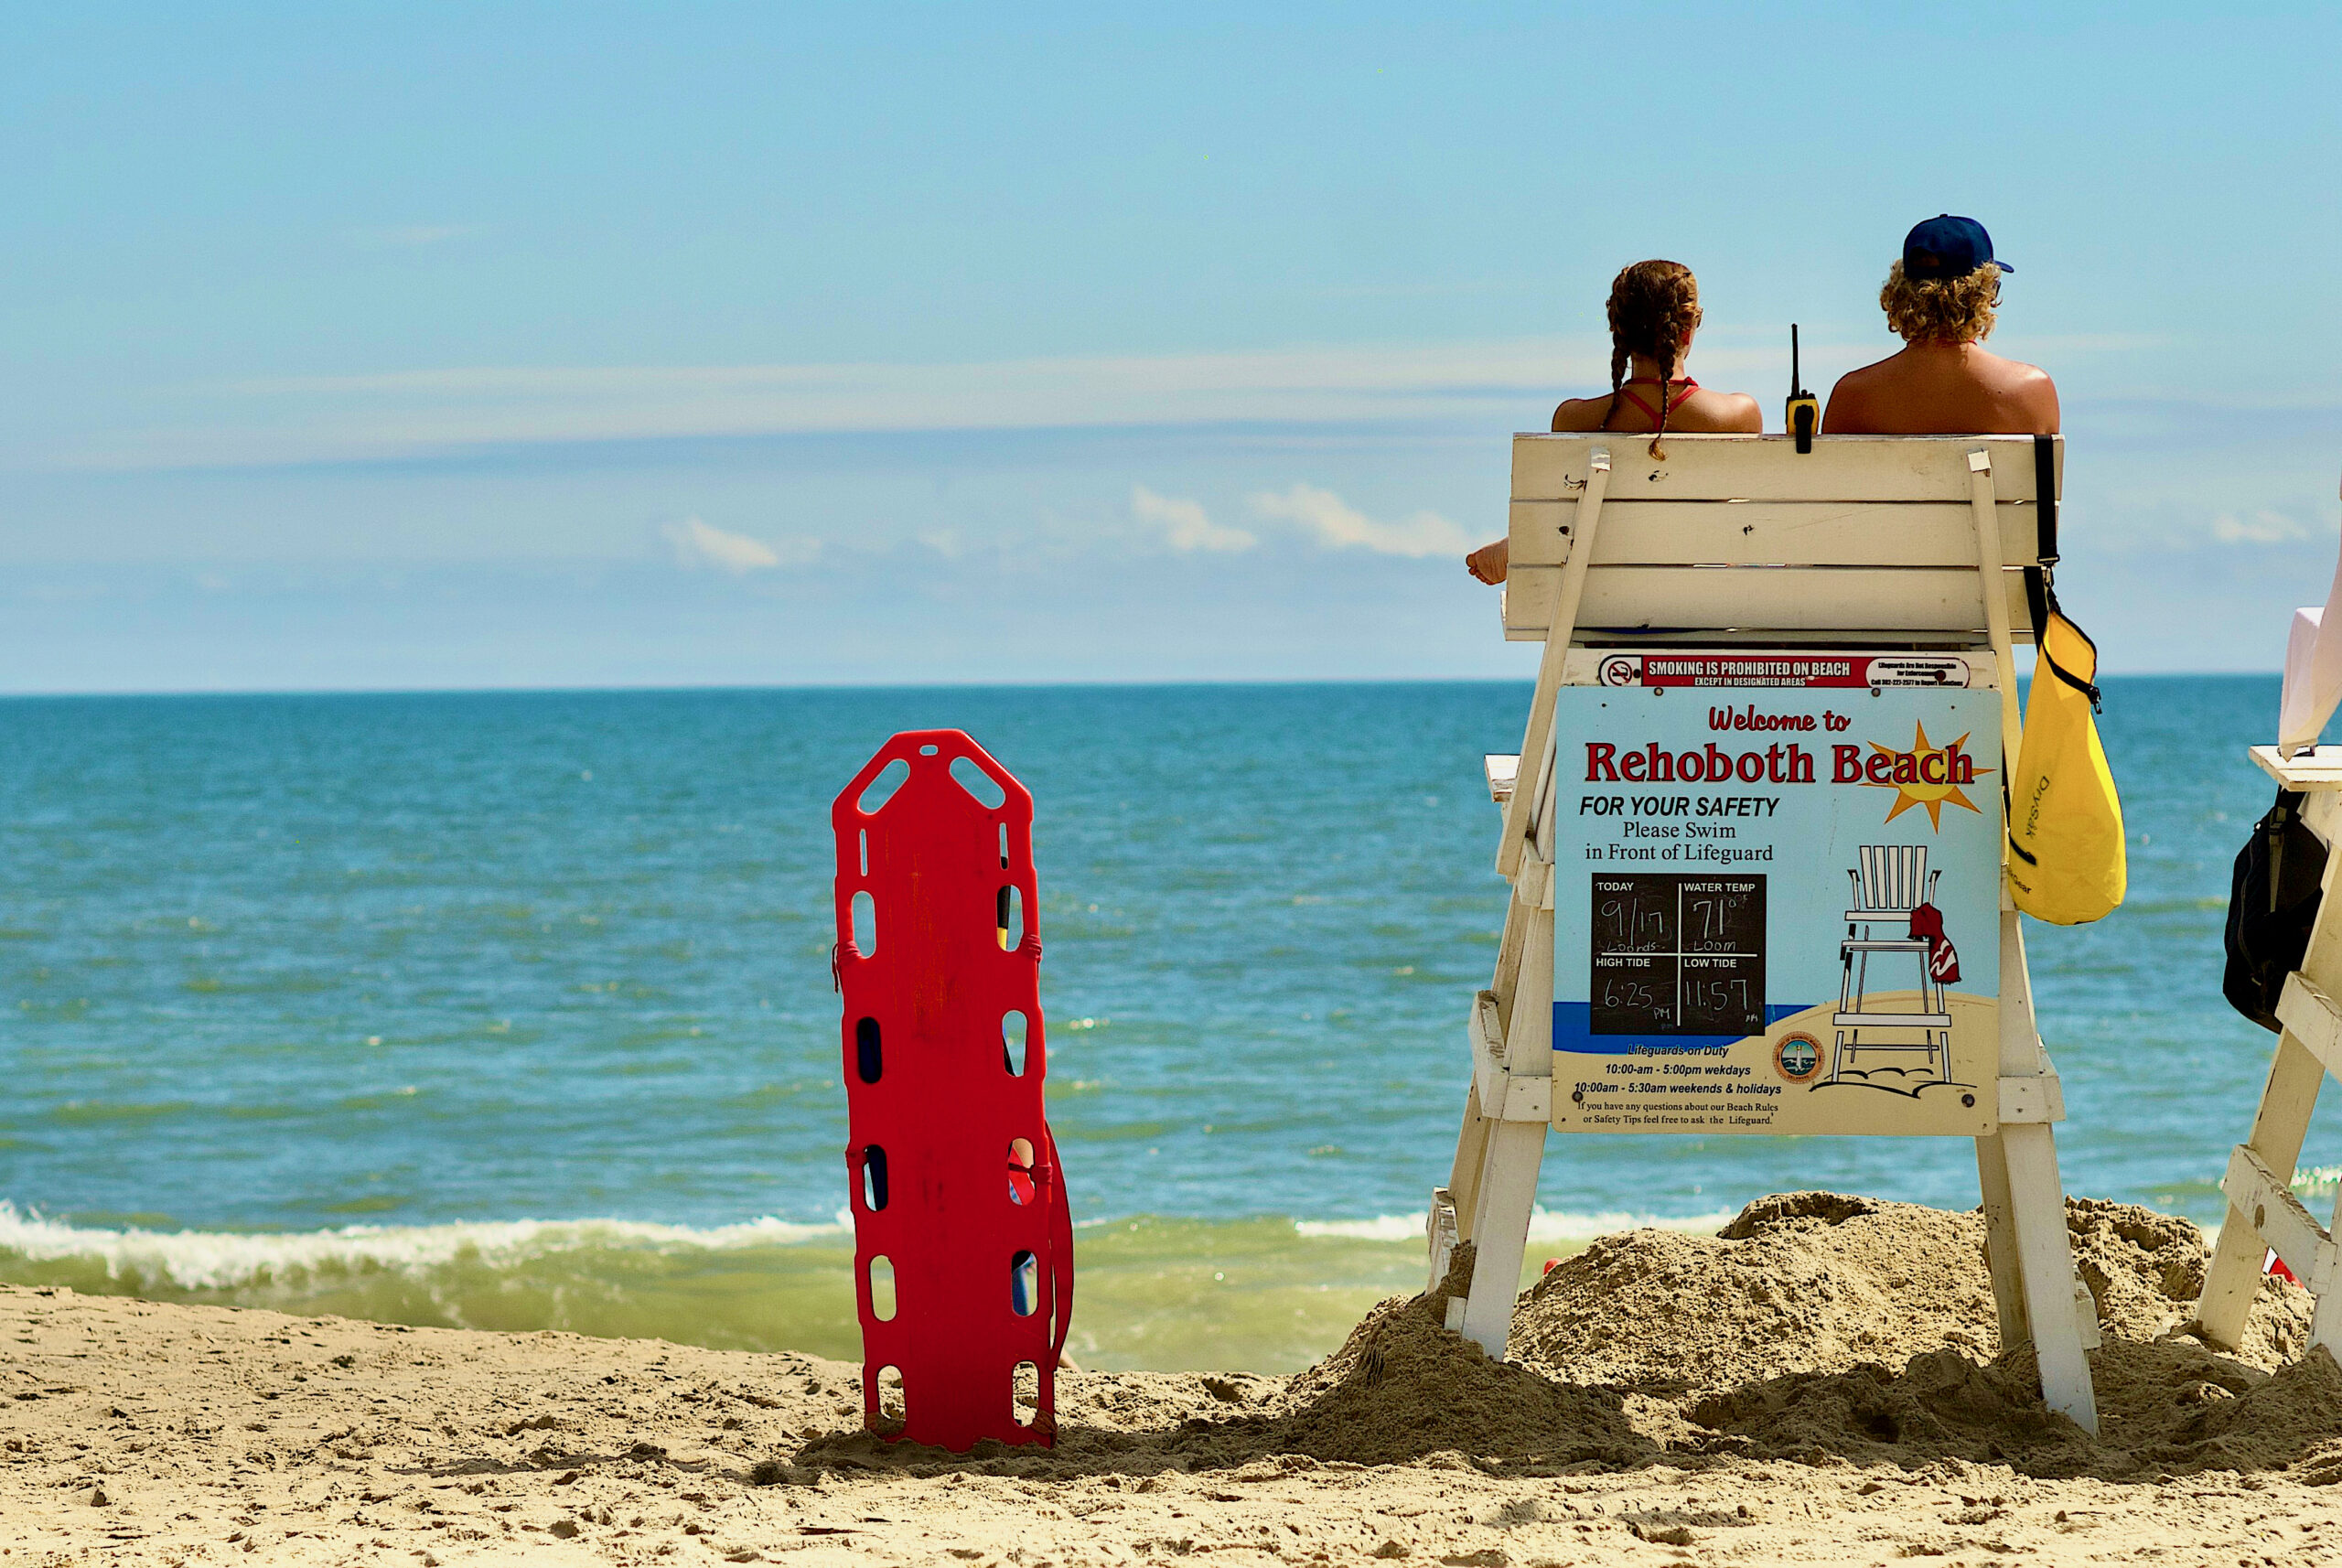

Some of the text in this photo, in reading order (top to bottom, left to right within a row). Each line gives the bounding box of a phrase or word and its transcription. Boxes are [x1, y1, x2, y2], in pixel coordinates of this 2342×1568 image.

[1649, 661, 1850, 676] SMOKING IS PROHIBITED ON BEACH
[1694, 677, 1806, 686] EXCEPT IN DESIGNATED AREAS
[1709, 704, 1851, 732] Welcome to
[1585, 742, 1974, 784] Rehoboth Beach
[1580, 797, 1779, 817] FOR YOUR SAFETY
[1623, 822, 1736, 839] Please Swim
[1586, 843, 1773, 865] in Front of Lifeguard
[1597, 882, 1634, 891] TODAY
[1684, 883, 1756, 892] WATER TEMP
[1601, 898, 1663, 946] 9/17
[1595, 958, 1650, 967] HIGH TIDE
[1684, 959, 1736, 968] LOW TIDE
[1605, 979, 1652, 1008] 6:25
[1687, 980, 1747, 1010] 11:57
[1654, 1008, 1671, 1020] PM
[1628, 1045, 1729, 1058] Lifeguards on Duty
[1606, 1064, 1653, 1074] 10:00-am
[1663, 1065, 1702, 1077] 5:00pm
[1704, 1065, 1751, 1077] wekdays
[1574, 1082, 1618, 1092] 10:00am
[1628, 1083, 1667, 1093] 5:30am
[1670, 1083, 1722, 1093] weekends
[1725, 1084, 1734, 1093] &
[1736, 1084, 1781, 1096] holidays
[1586, 1104, 1601, 1112] you
[1605, 1102, 1623, 1111] have
[1643, 1103, 1682, 1112] questions
[1727, 1103, 1753, 1112] Beach
[1756, 1103, 1778, 1112] Rules
[1595, 1115, 1620, 1125] Safety
[1623, 1115, 1641, 1125] Tips
[1644, 1115, 1659, 1123] feel
[1661, 1115, 1678, 1123] free
